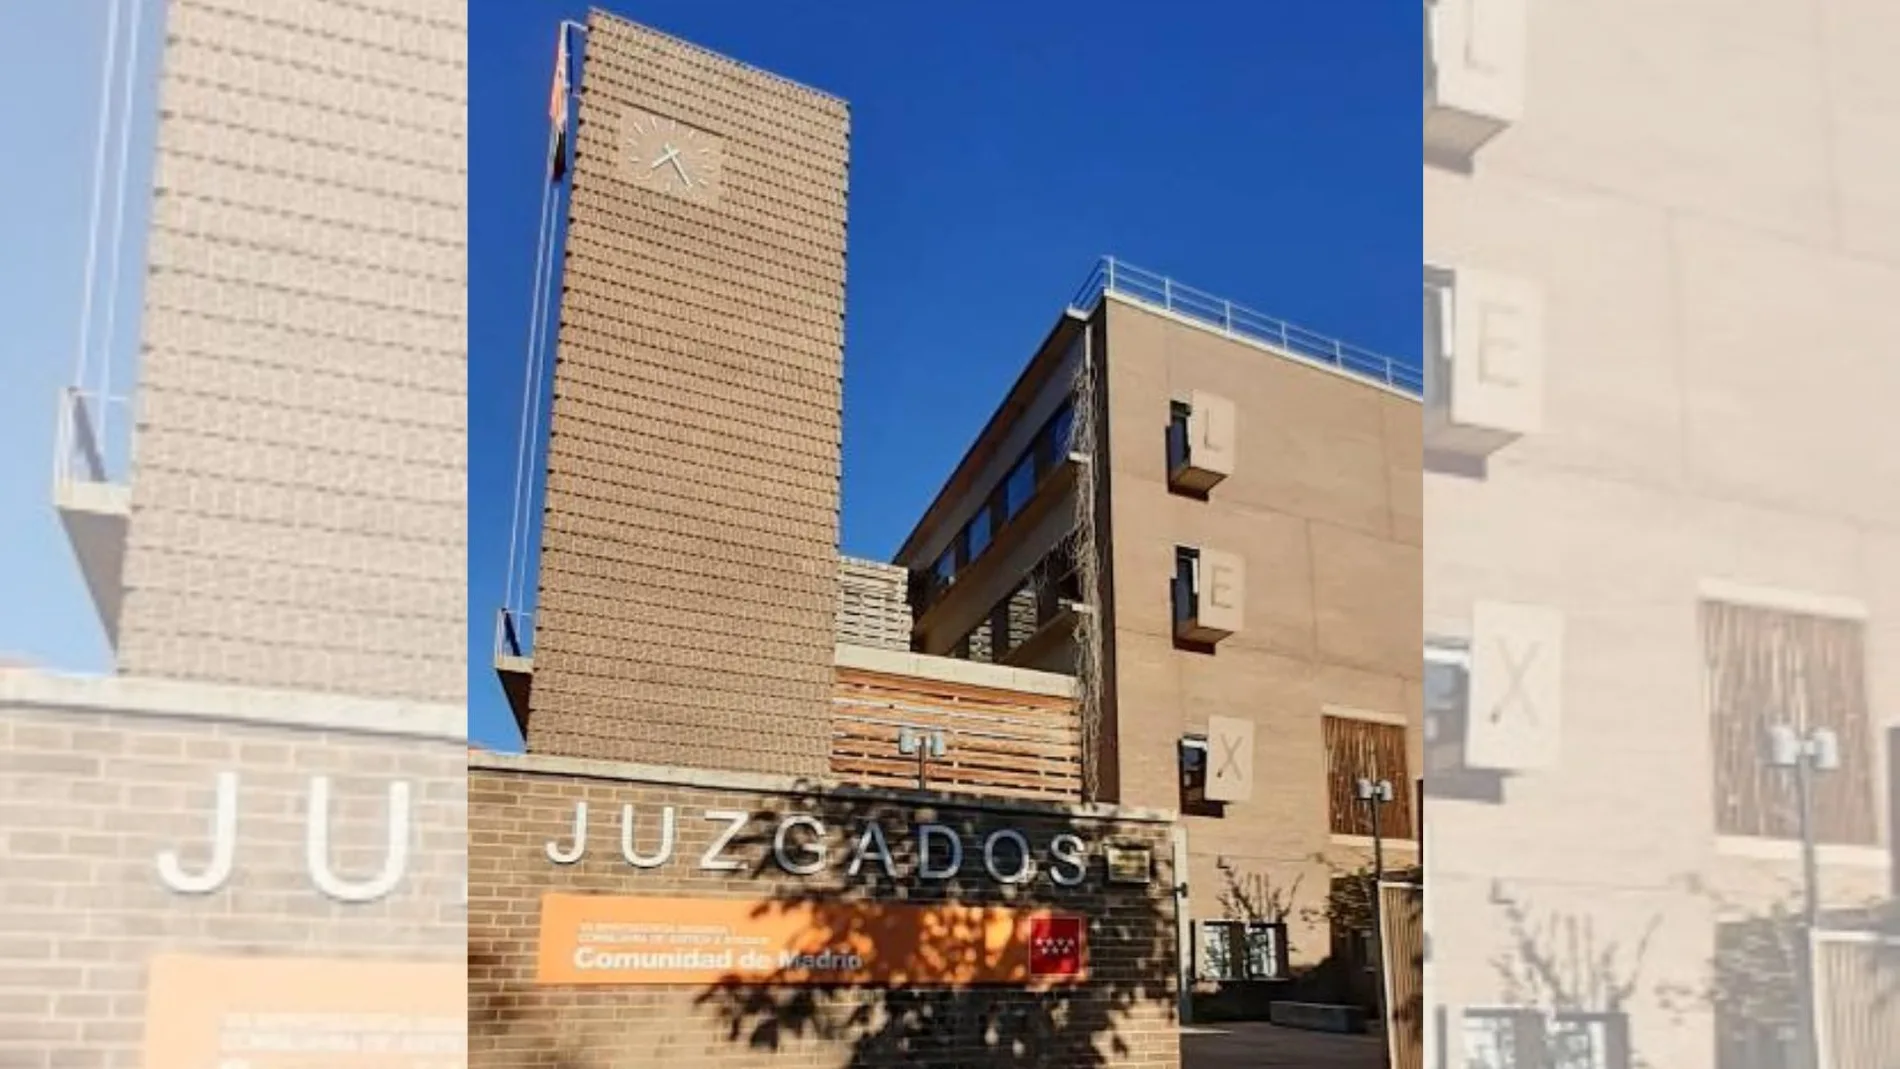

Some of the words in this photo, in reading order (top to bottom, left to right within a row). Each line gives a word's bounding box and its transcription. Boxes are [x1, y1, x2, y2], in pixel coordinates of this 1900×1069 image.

[544, 801, 1088, 887] JUZGADOS
[574, 946, 733, 970] Comunidad
[739, 948, 773, 970] de
[779, 948, 863, 970] Madrid
